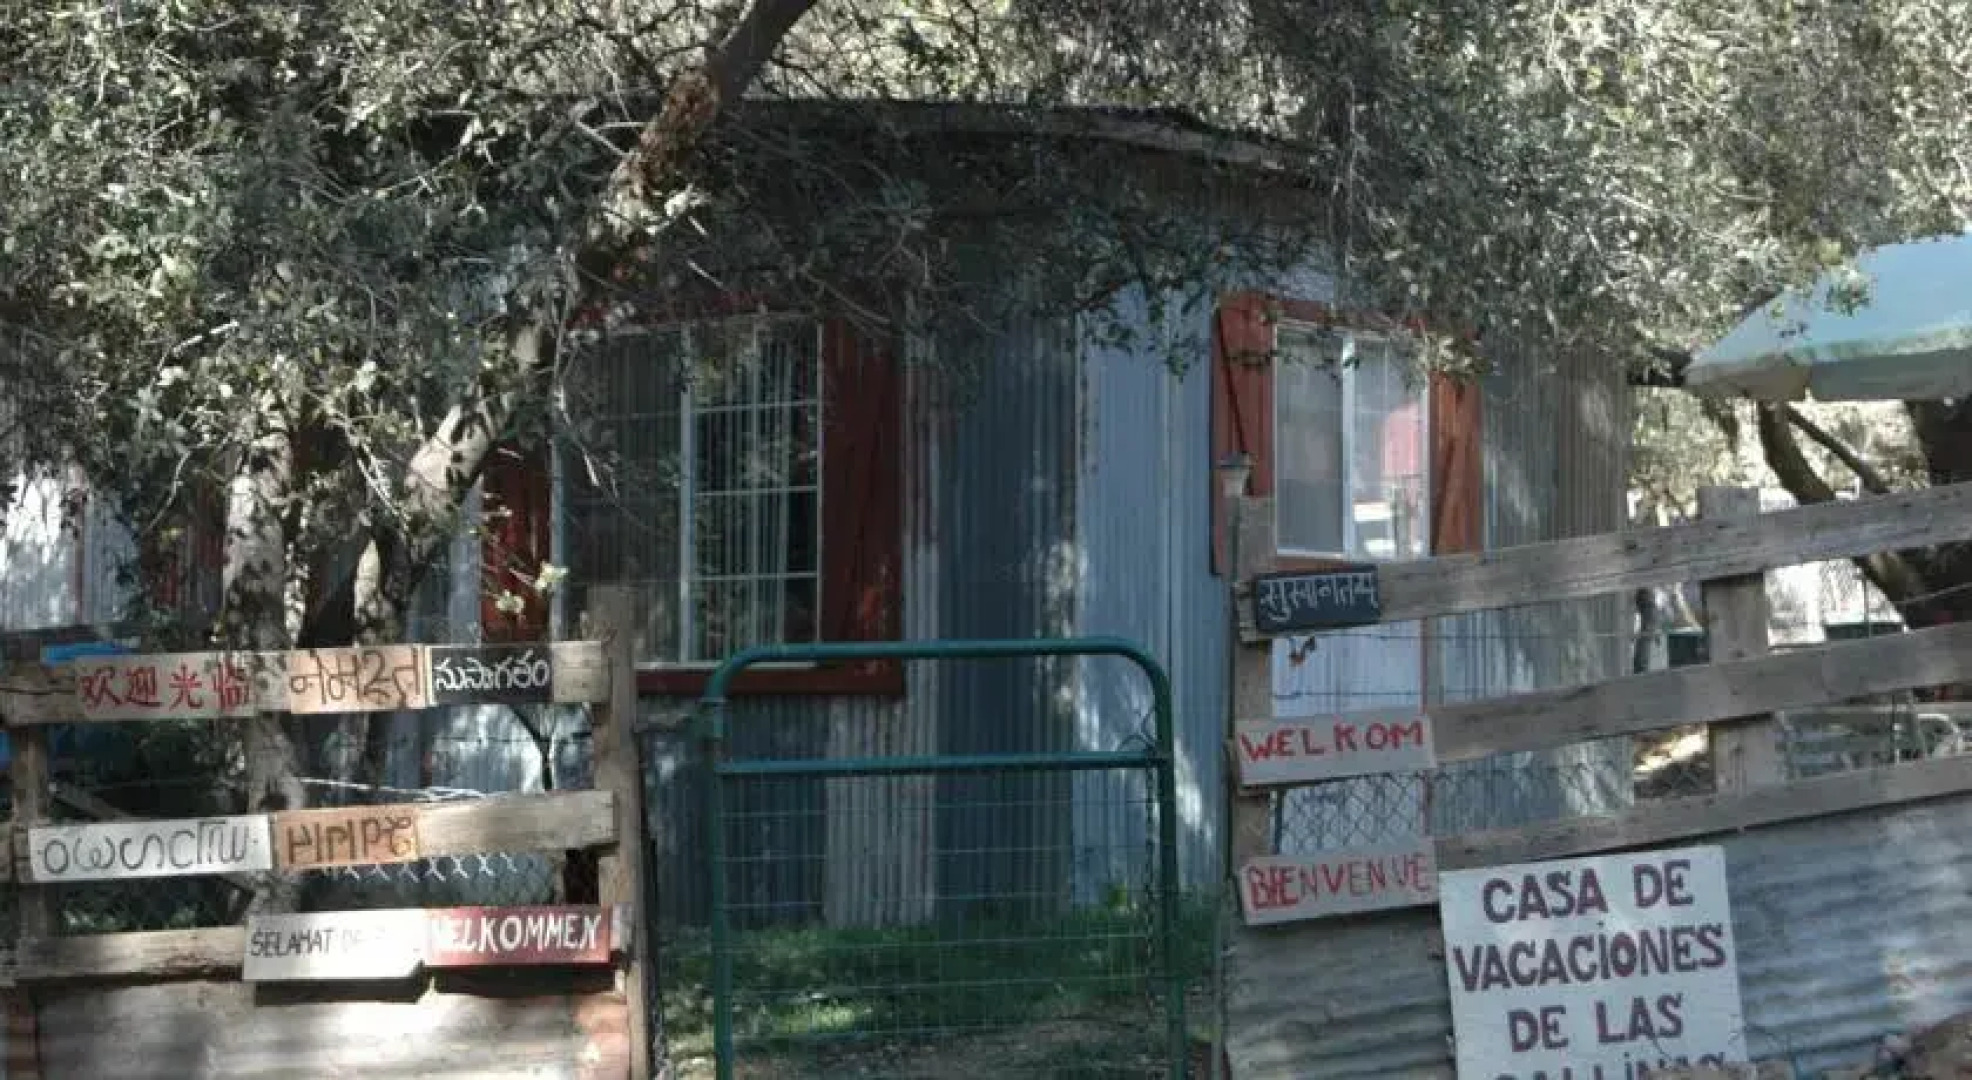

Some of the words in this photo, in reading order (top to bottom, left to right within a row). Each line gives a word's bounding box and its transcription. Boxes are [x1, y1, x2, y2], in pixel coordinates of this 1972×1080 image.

[79, 659, 250, 712] 欢迎光临
[1241, 720, 1424, 763] WELKOM
[1247, 853, 1431, 909] BIENVENUE
[1482, 868, 1608, 923] CASA
[1633, 859, 1695, 908] DE
[1507, 1005, 1569, 1053] DE
[1594, 993, 1684, 1043] LAS
